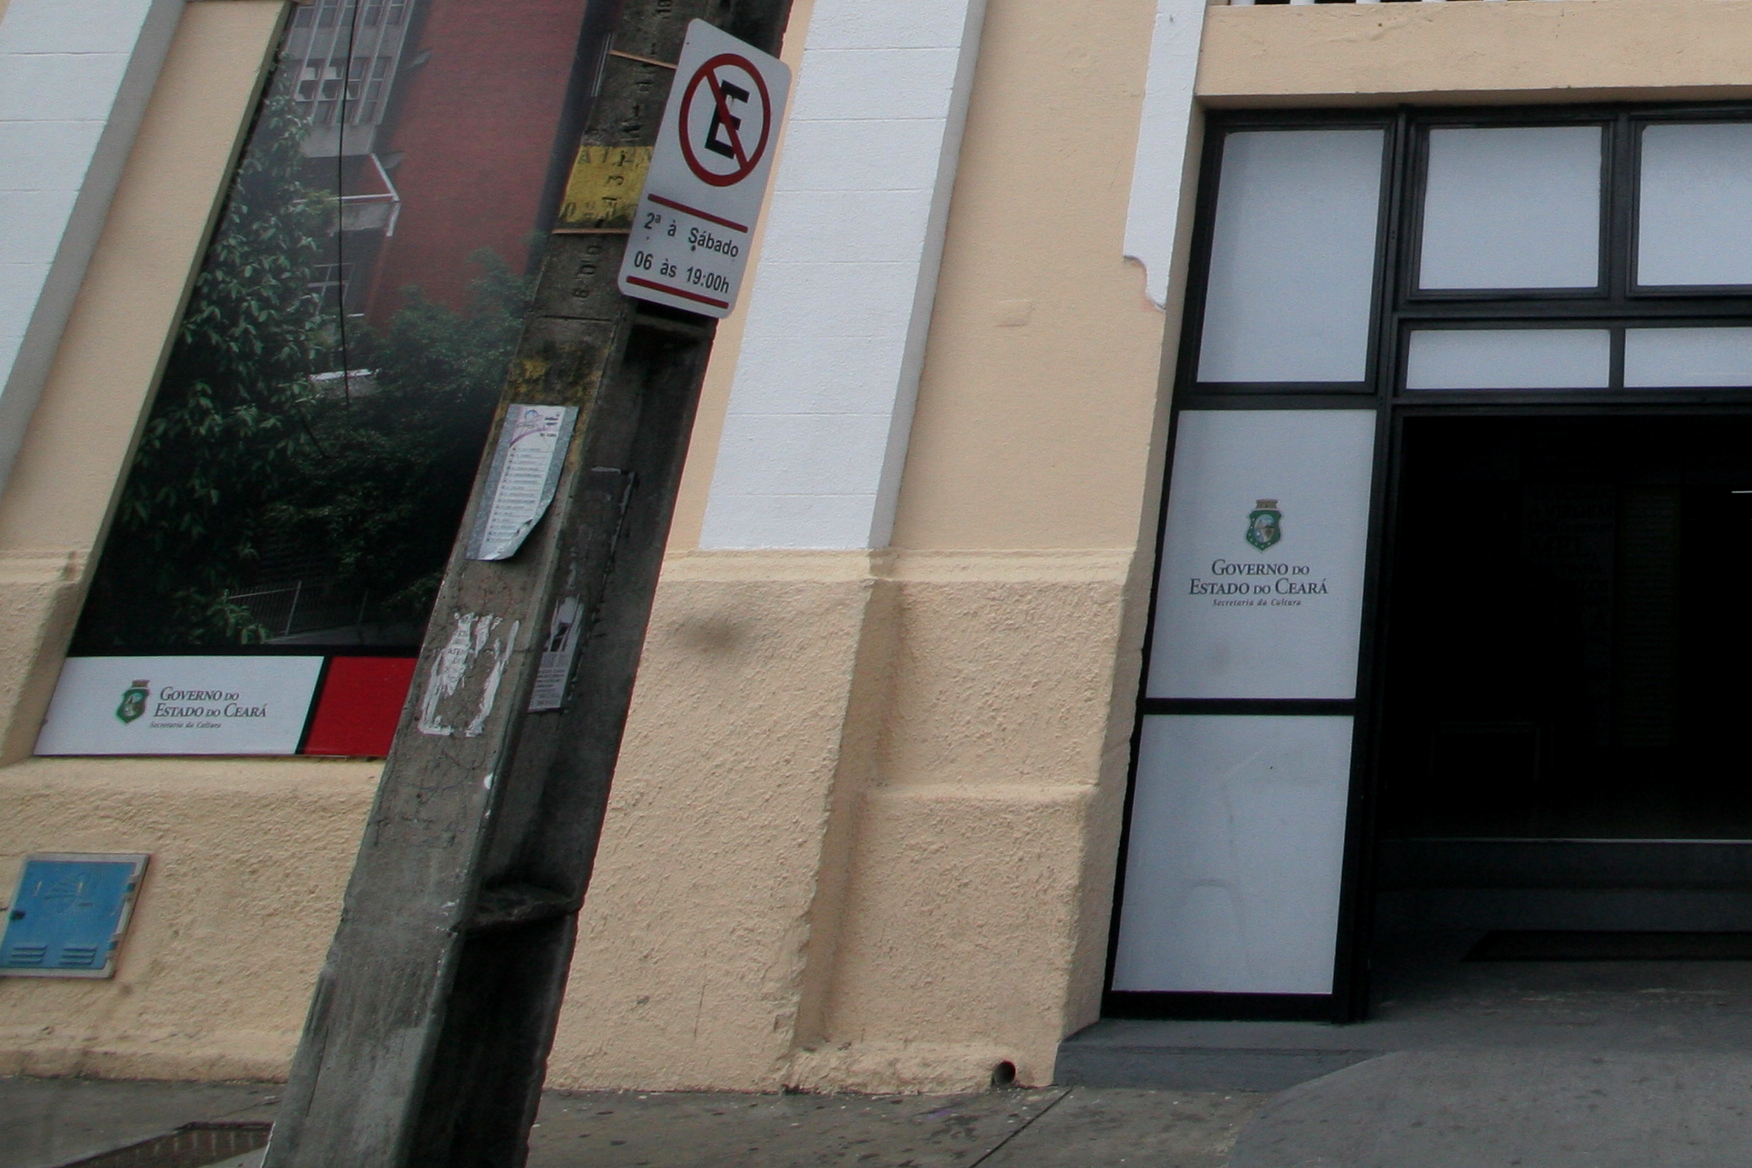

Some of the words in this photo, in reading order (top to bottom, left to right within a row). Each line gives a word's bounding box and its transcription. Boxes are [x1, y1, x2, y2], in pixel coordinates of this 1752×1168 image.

[667, 218, 677, 238] à
[688, 226, 740, 259] Sábado
[633, 249, 653, 271] 06
[659, 253, 678, 279] às
[685, 264, 731, 295] 19:00h
[1211, 558, 1289, 576] GOVERNO
[1292, 565, 1311, 576] DO
[1188, 578, 1250, 595] ESTADO
[1253, 584, 1271, 595] DO
[1274, 577, 1329, 595] CEARÁ
[1212, 598, 1252, 607] Secretaria
[1270, 598, 1301, 607] Cultura
[159, 686, 223, 702] GOVERNO
[223, 692, 240, 702] DO
[153, 702, 204, 718] ESTADO
[205, 709, 221, 718] DO
[224, 702, 268, 718] CEARÁ
